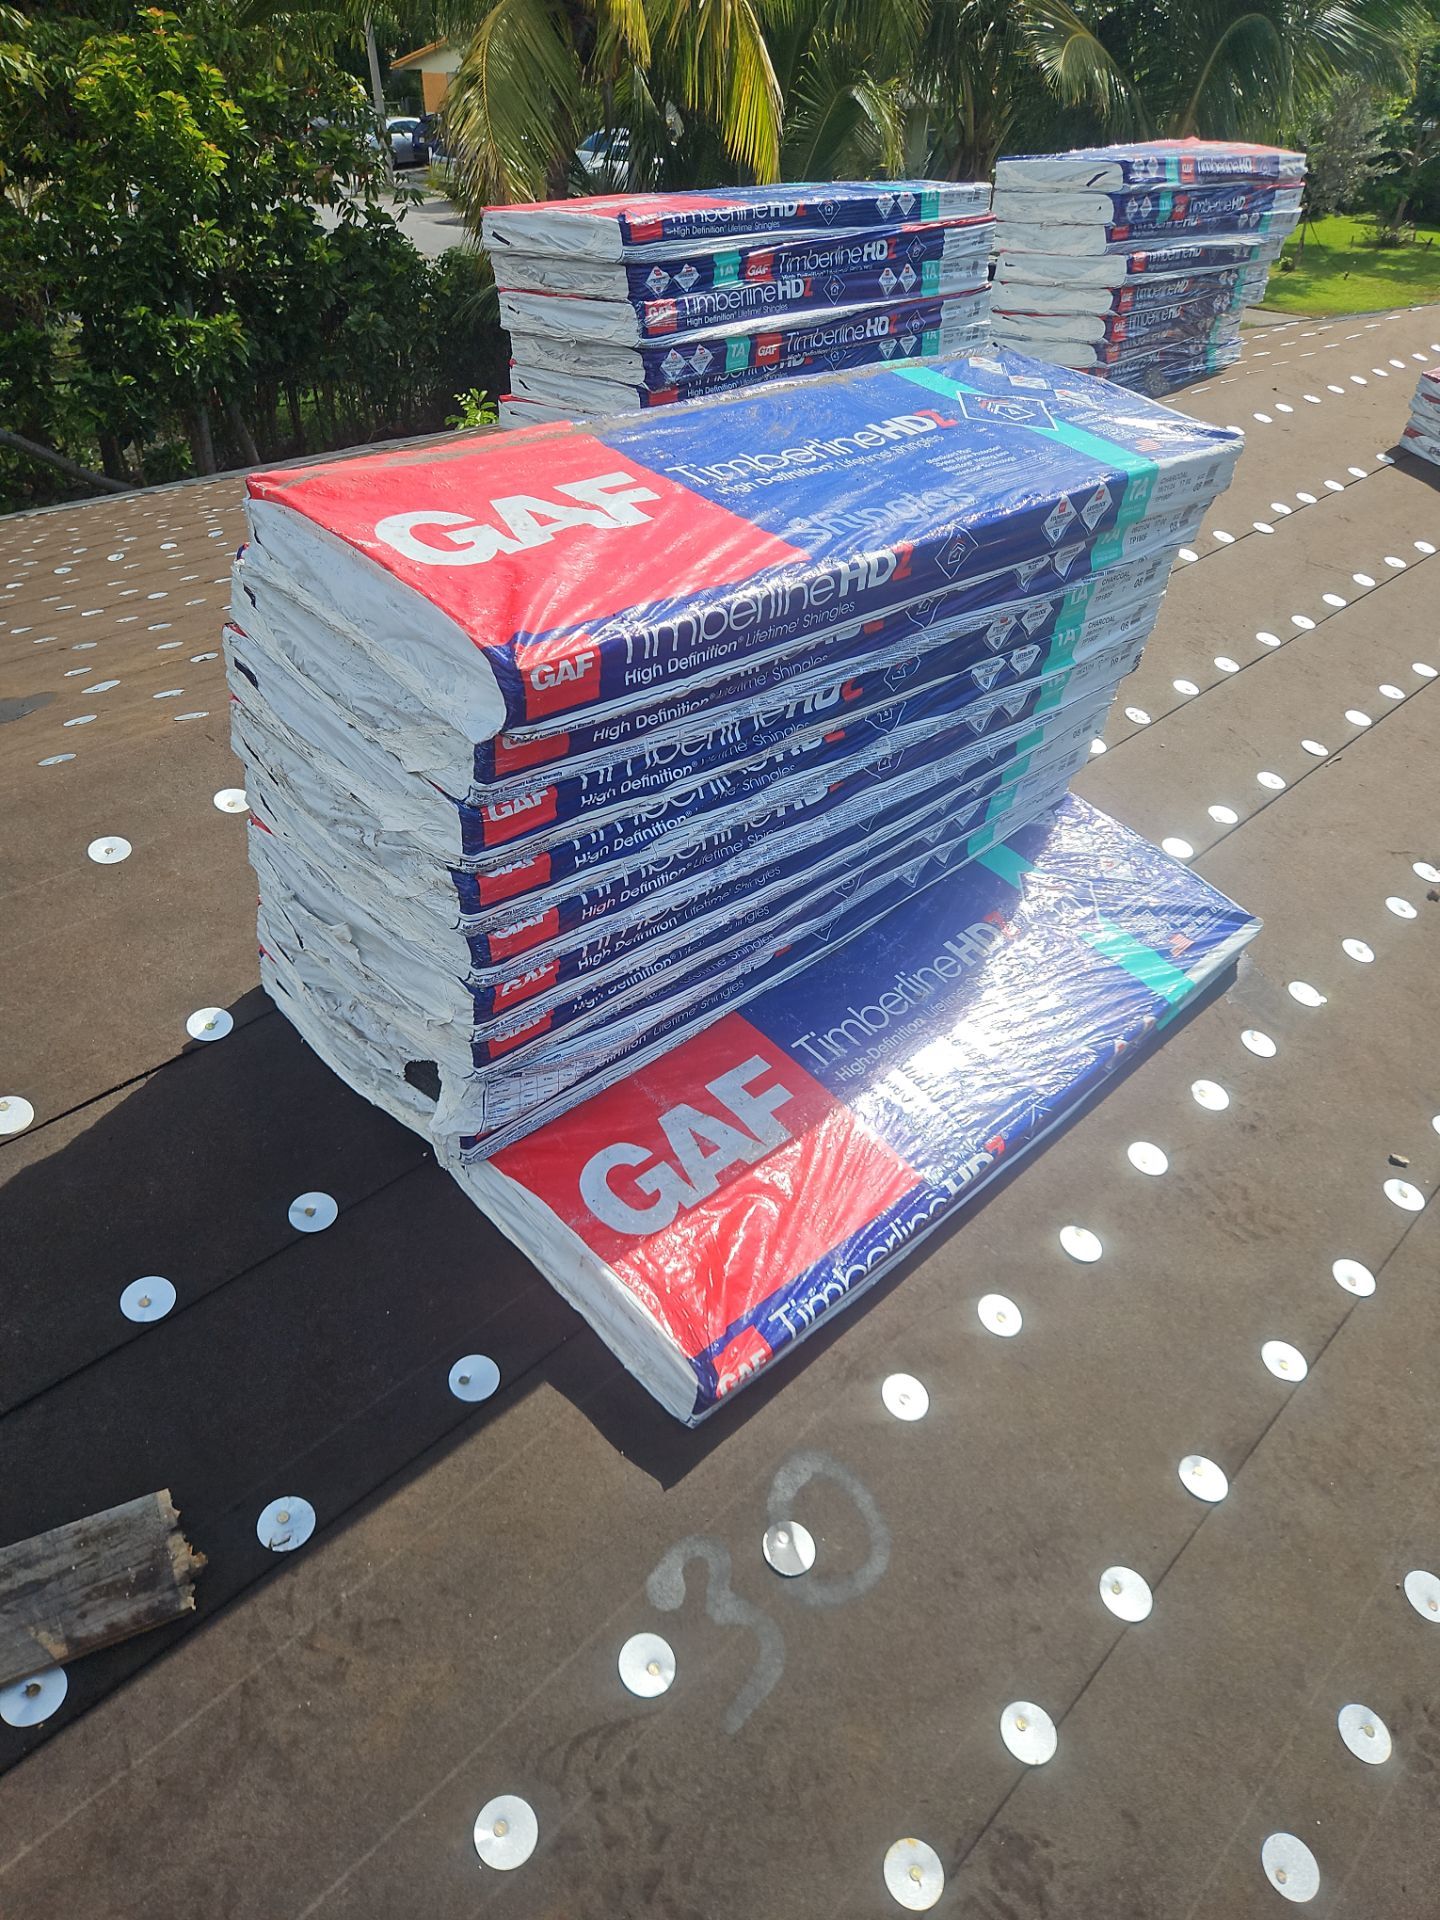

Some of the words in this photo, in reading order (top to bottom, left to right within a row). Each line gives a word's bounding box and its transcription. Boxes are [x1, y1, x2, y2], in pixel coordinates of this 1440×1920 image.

[747, 263, 770, 277] GAF
[778, 238, 898, 274] TimberlineHDZ
[684, 279, 814, 316] TimberlineHDZ
[686, 315, 703, 327] High
[786, 313, 898, 352] TimberlineHDZ
[731, 342, 745, 358] TA
[757, 346, 777, 357] GAF
[687, 387, 704, 398] High
[665, 408, 960, 485] TimberlineHDZ
[715, 477, 758, 495] High
[890, 433, 945, 455] Shingles
[374, 471, 662, 566] GAF
[787, 487, 976, 547] Shingles
[1101, 570, 1131, 587] CHARCOAL
[618, 543, 914, 664] TimberlineHDZ
[1087, 615, 1116, 630] CHARCOAL
[624, 661, 663, 686] High
[802, 601, 856, 628] Shingles
[530, 651, 596, 691] GAF
[593, 718, 631, 743] High
[580, 787, 616, 808] High
[574, 844, 609, 868] High
[577, 947, 611, 971] High
[734, 866, 781, 895] Shingles
[581, 898, 616, 921] High
[836, 1054, 871, 1082] High
[579, 1054, 795, 1236] GAF
